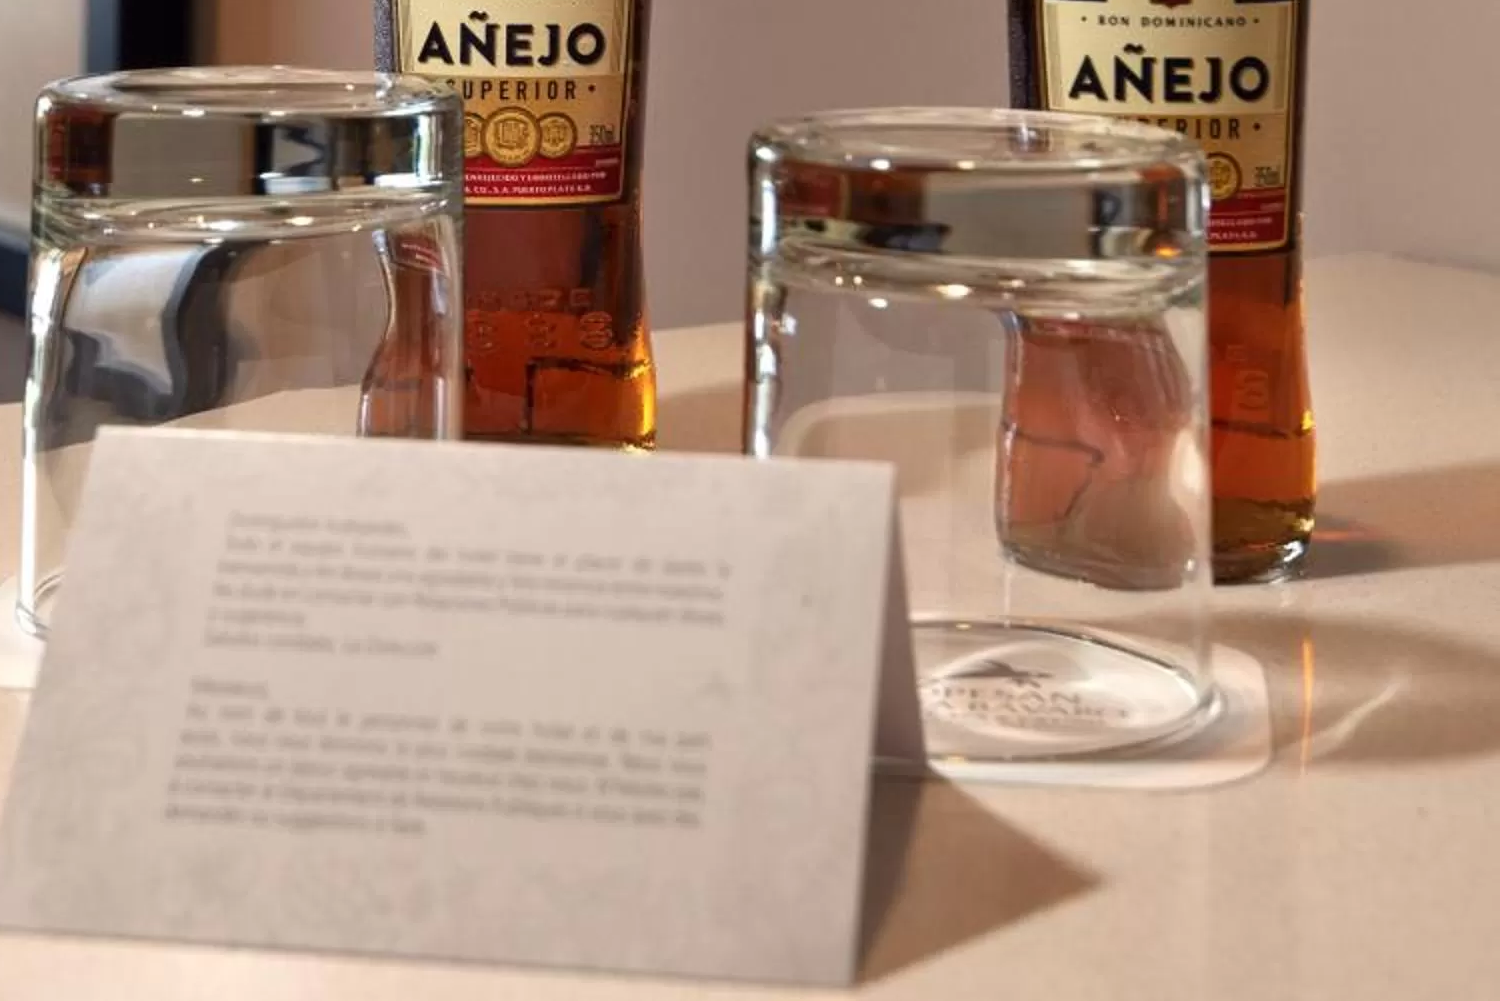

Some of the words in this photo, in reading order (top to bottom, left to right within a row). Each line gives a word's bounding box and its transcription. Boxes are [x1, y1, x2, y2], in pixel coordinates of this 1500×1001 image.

[417, 10, 607, 67] AÑEJO
[1098, 14, 1130, 27] RON
[1141, 15, 1248, 28] DOMINICANO
[1068, 43, 1270, 104] AÑEJO
